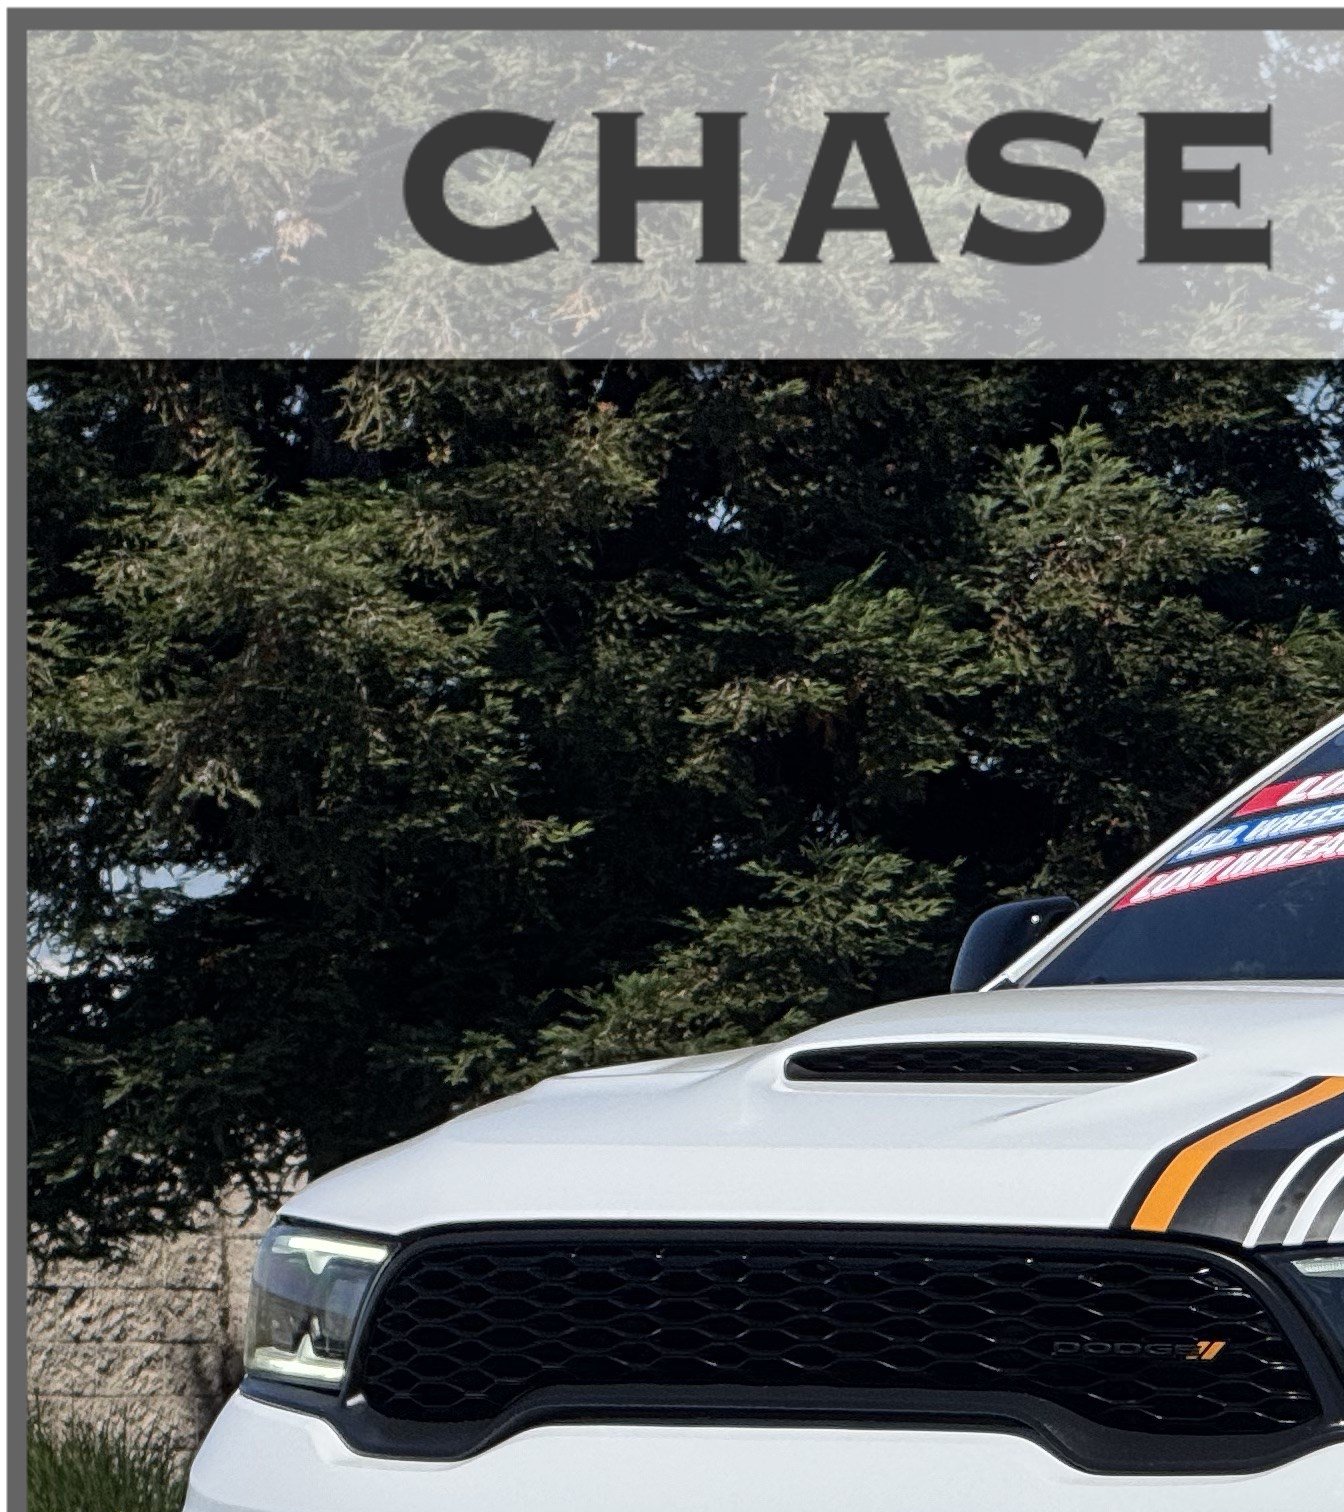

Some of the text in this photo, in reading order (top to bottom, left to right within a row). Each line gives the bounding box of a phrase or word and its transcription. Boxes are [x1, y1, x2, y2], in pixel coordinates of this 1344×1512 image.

[1173, 824, 1248, 863] ALL
[1128, 855, 1237, 904] LOW
[1053, 1341, 1200, 1357] DODGE
